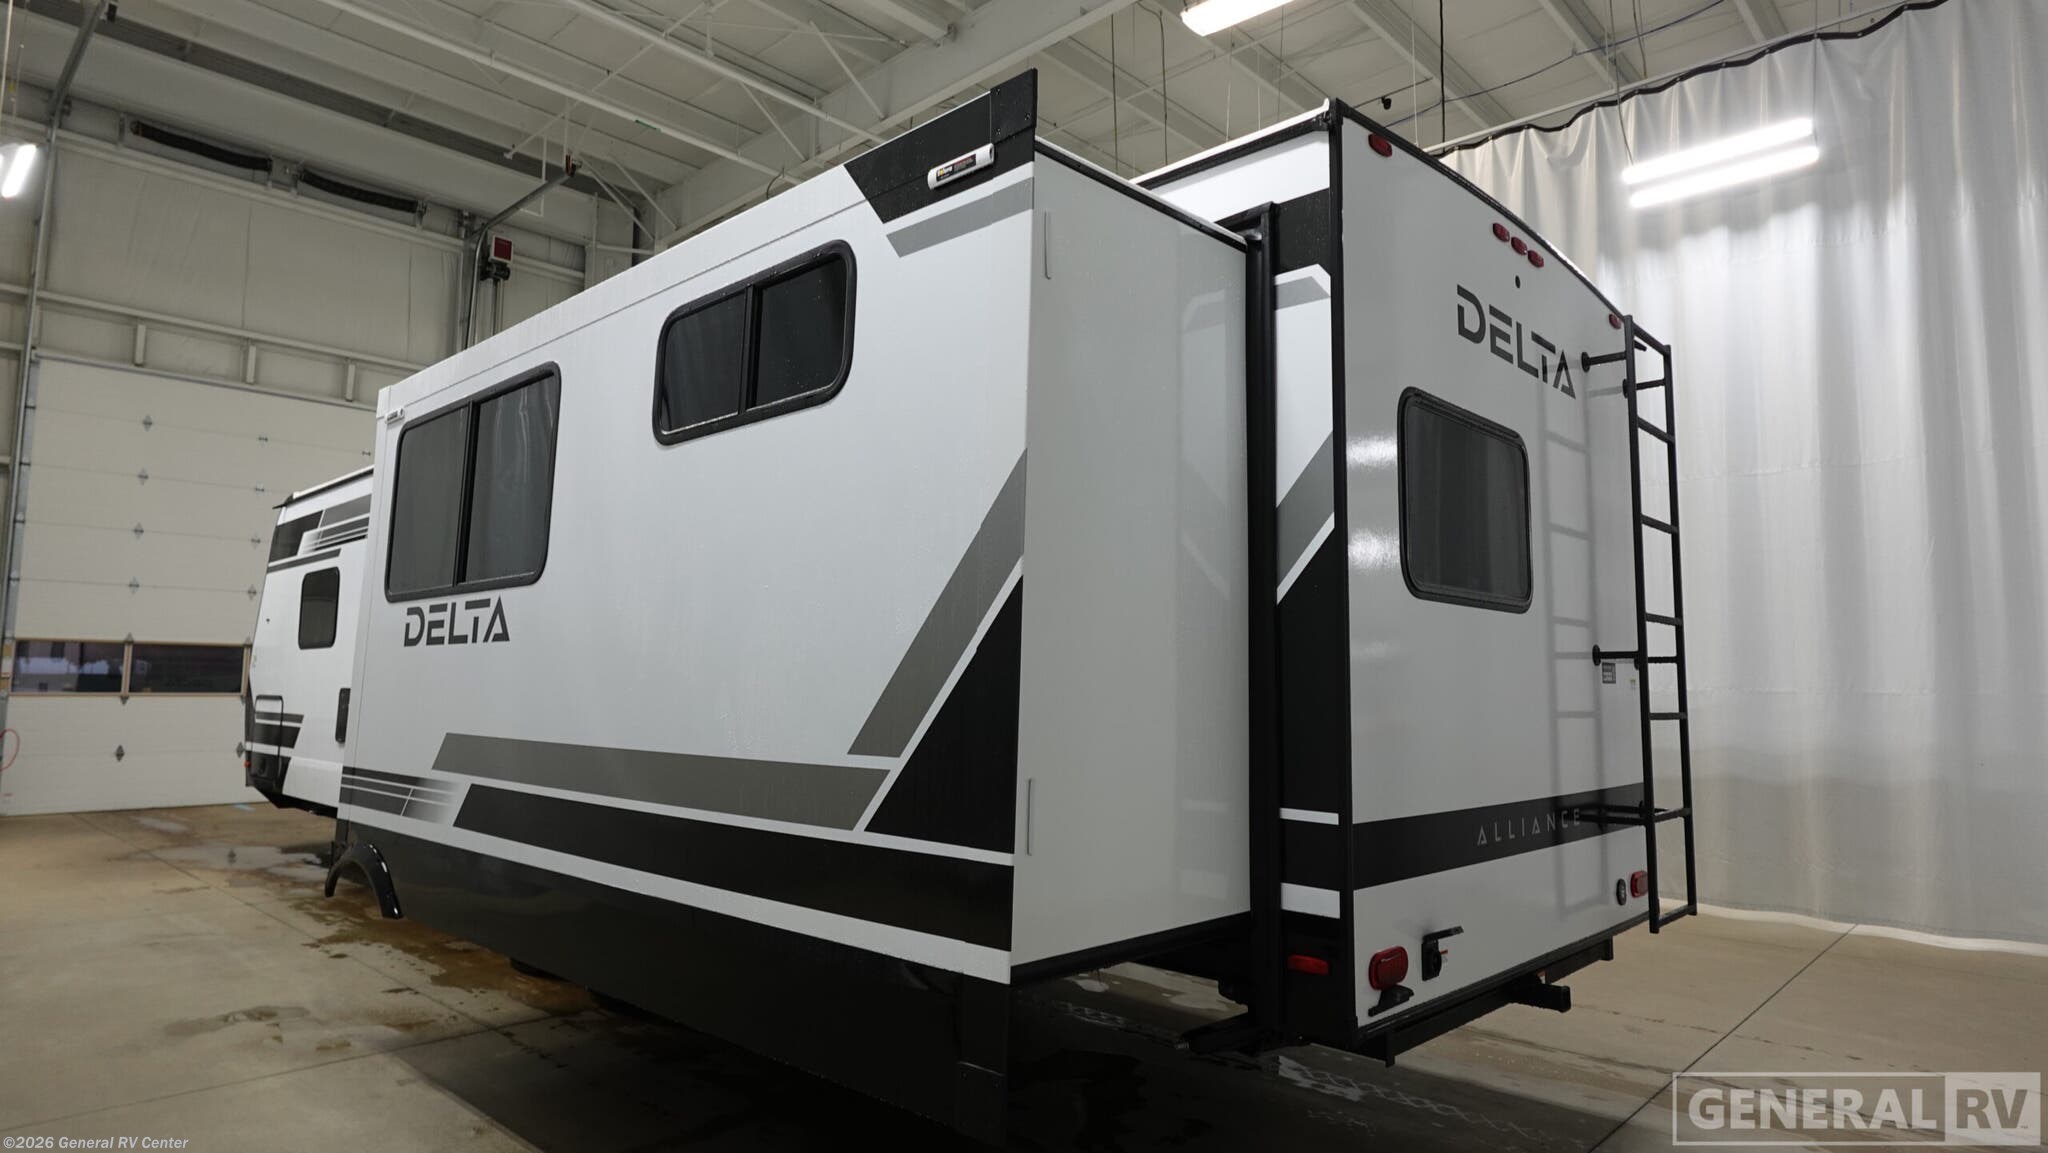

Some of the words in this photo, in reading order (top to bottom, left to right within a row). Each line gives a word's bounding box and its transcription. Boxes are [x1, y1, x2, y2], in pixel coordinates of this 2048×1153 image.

[1456, 284, 1576, 399] DELTA
[404, 595, 511, 647] DELTA
[1476, 808, 1581, 846] ALLIANCE
